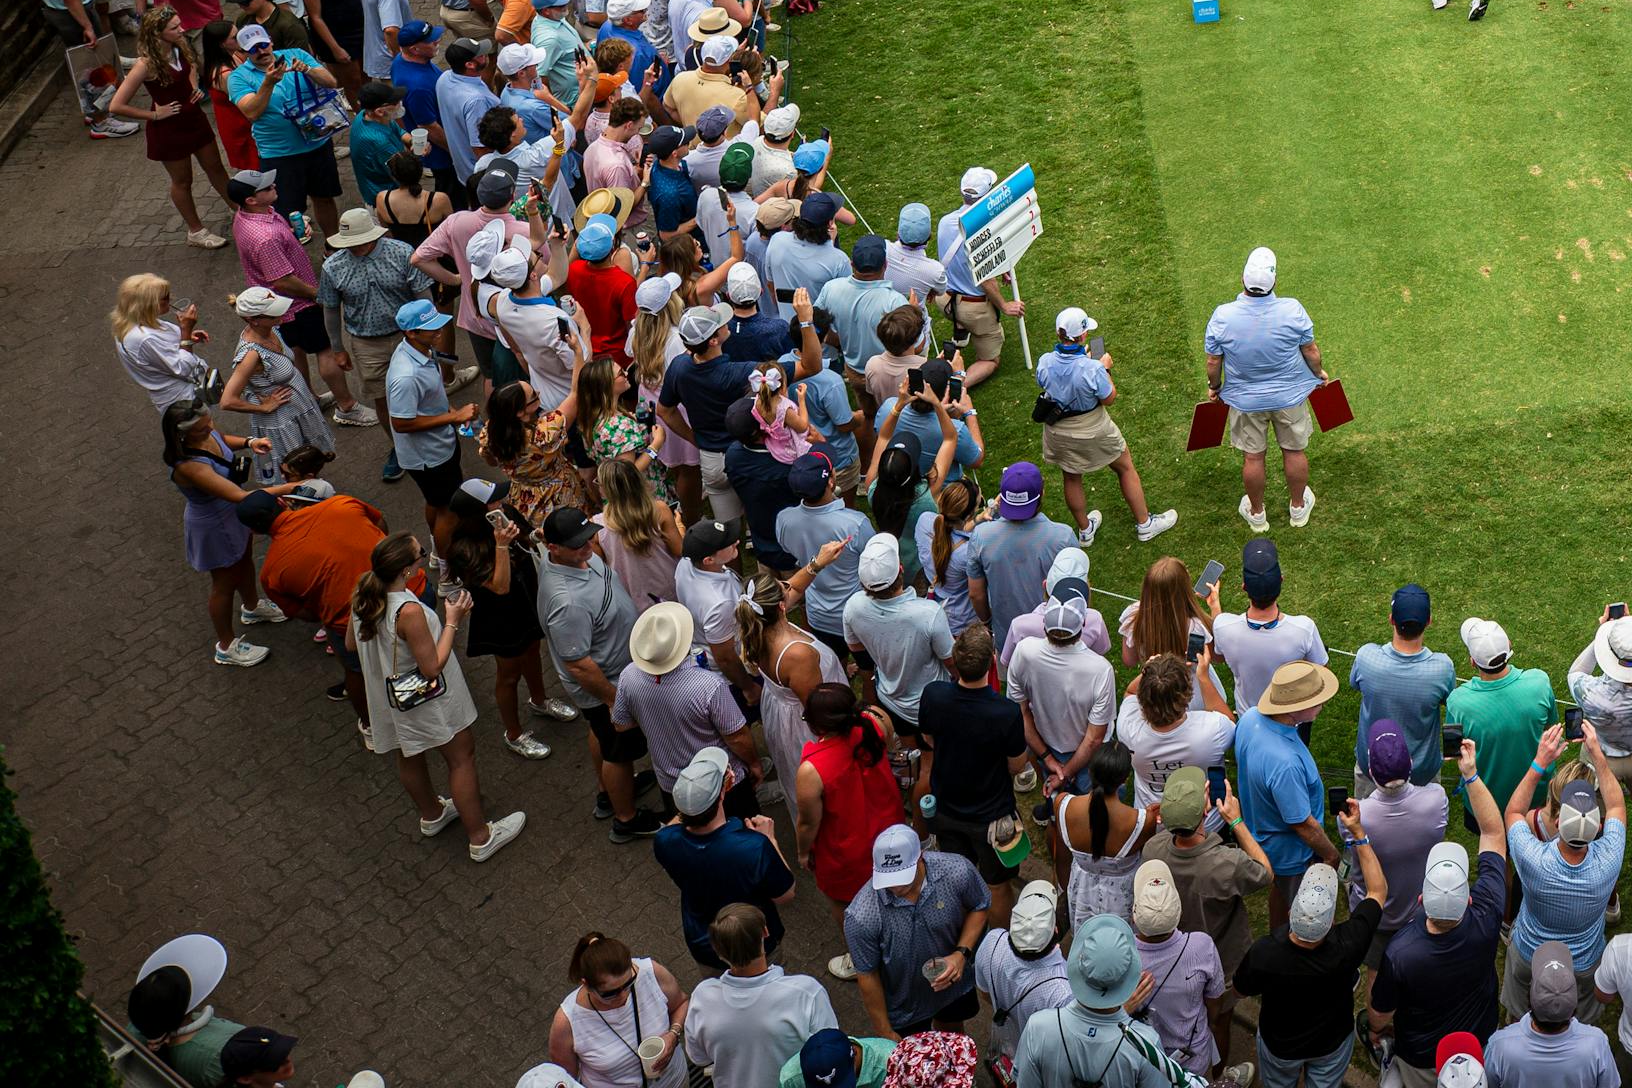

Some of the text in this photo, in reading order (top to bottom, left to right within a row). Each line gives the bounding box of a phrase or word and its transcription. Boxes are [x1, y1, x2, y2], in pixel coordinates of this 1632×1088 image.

[986, 185, 1012, 211] charles
[973, 237, 1003, 267] SCHEFFLER
[975, 224, 1038, 283] WOODLAND 2
[1152, 760, 1184, 770] Let
[1088, 1025, 1097, 1037] FJ
